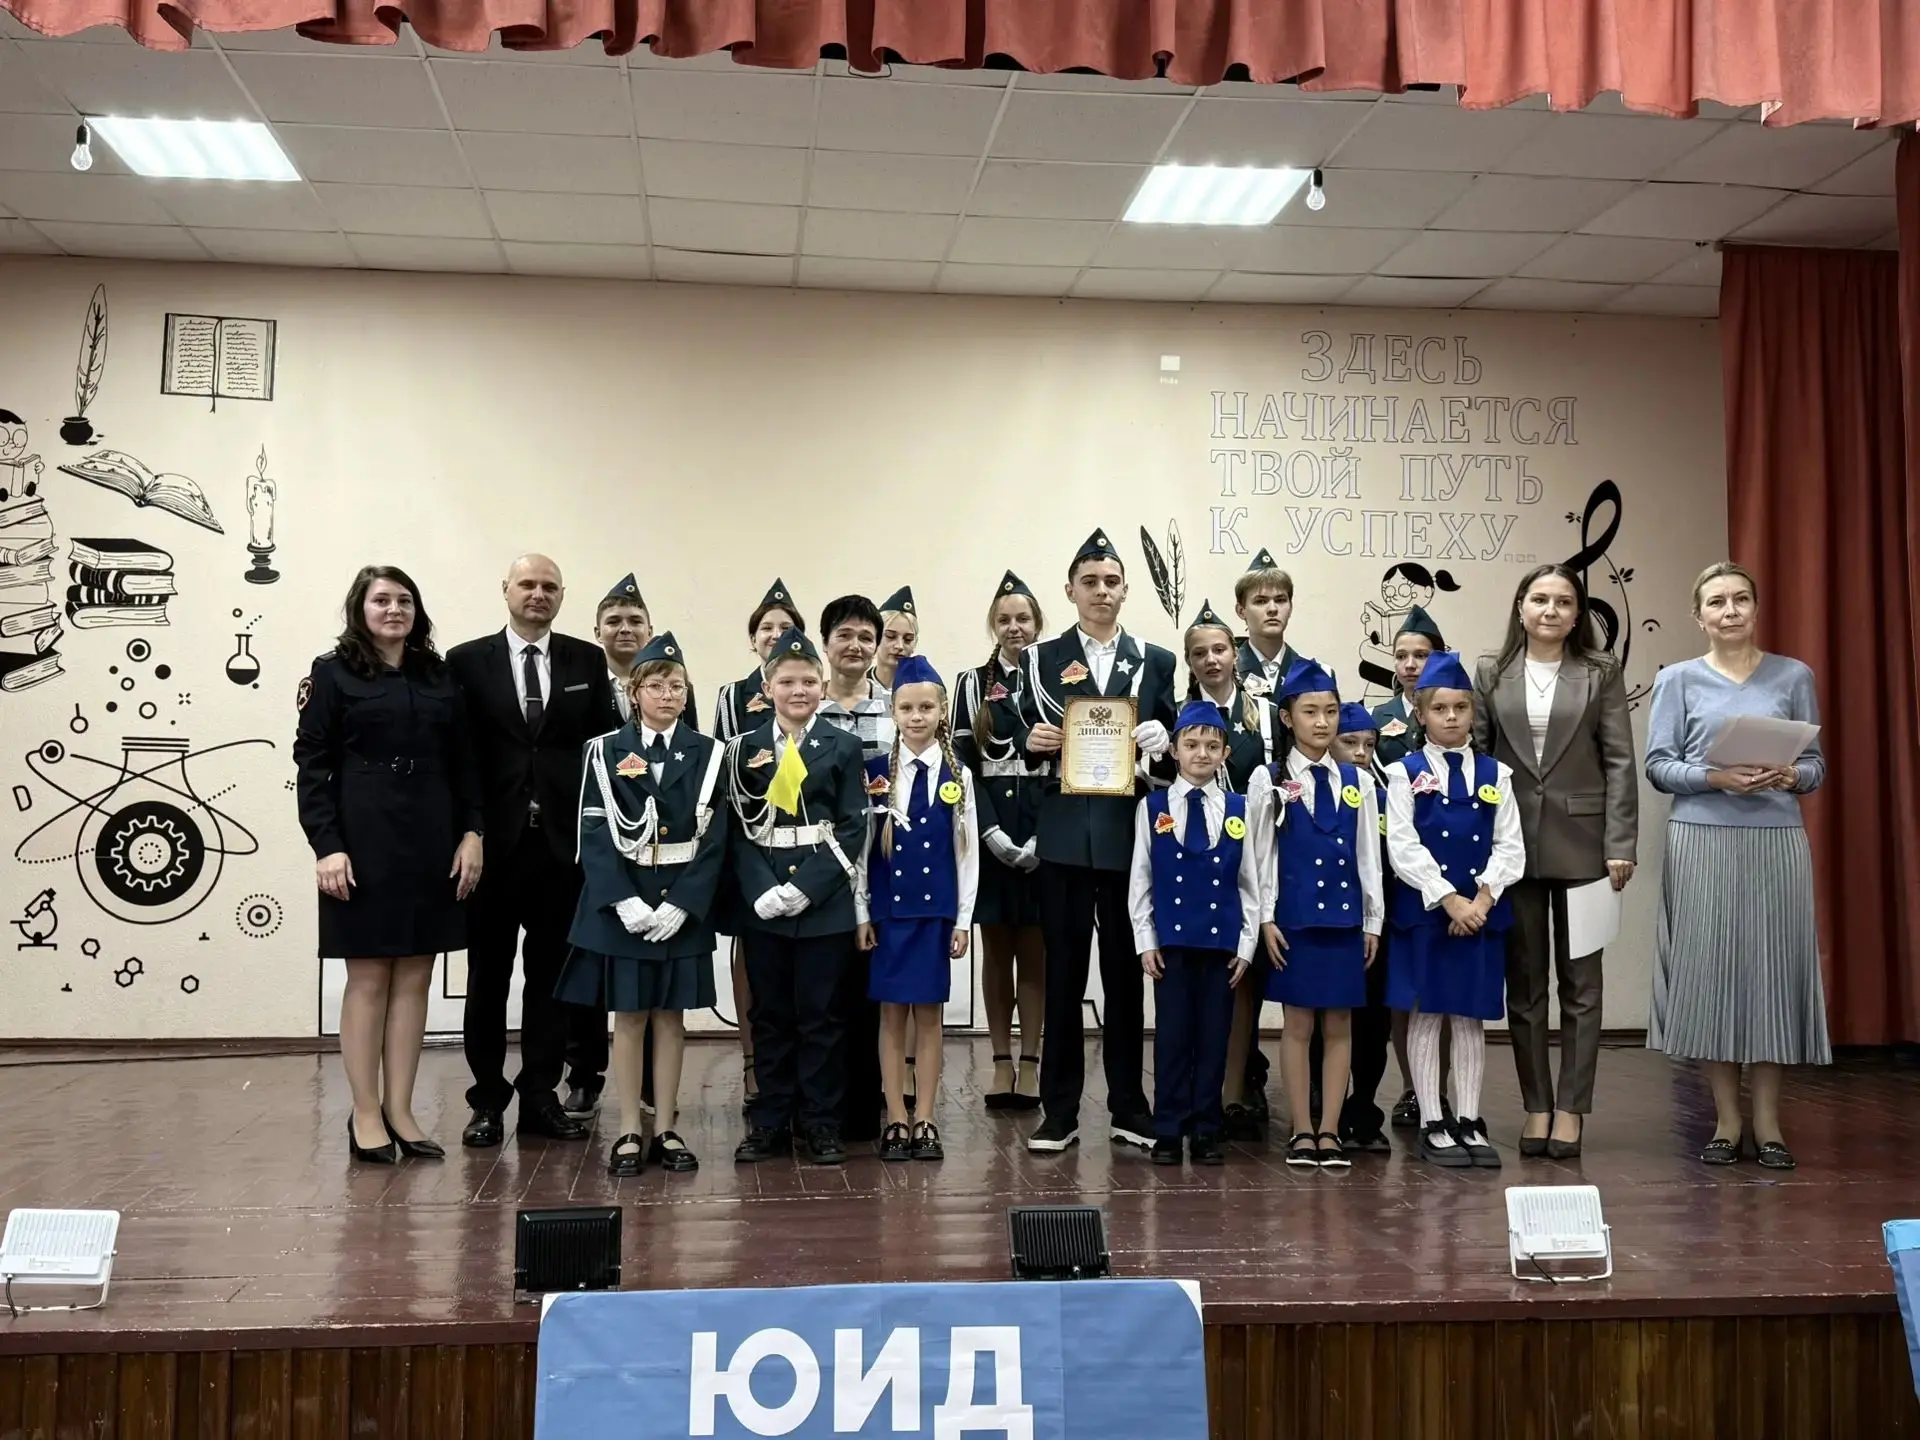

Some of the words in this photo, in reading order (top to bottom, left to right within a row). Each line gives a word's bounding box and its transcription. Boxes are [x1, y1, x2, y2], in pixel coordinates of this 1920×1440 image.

[1301, 330, 1483, 384] ЗДЕСЬ
[1210, 391, 1579, 445] НАЧИНАЕТСЯ
[1210, 446, 1361, 500] ТВОЙ
[1399, 454, 1543, 504] ПУТЬ
[1209, 507, 1249, 555] К
[1077, 727, 1122, 736] ДИПЛОМ
[689, 1326, 1033, 1440] ЮИД
